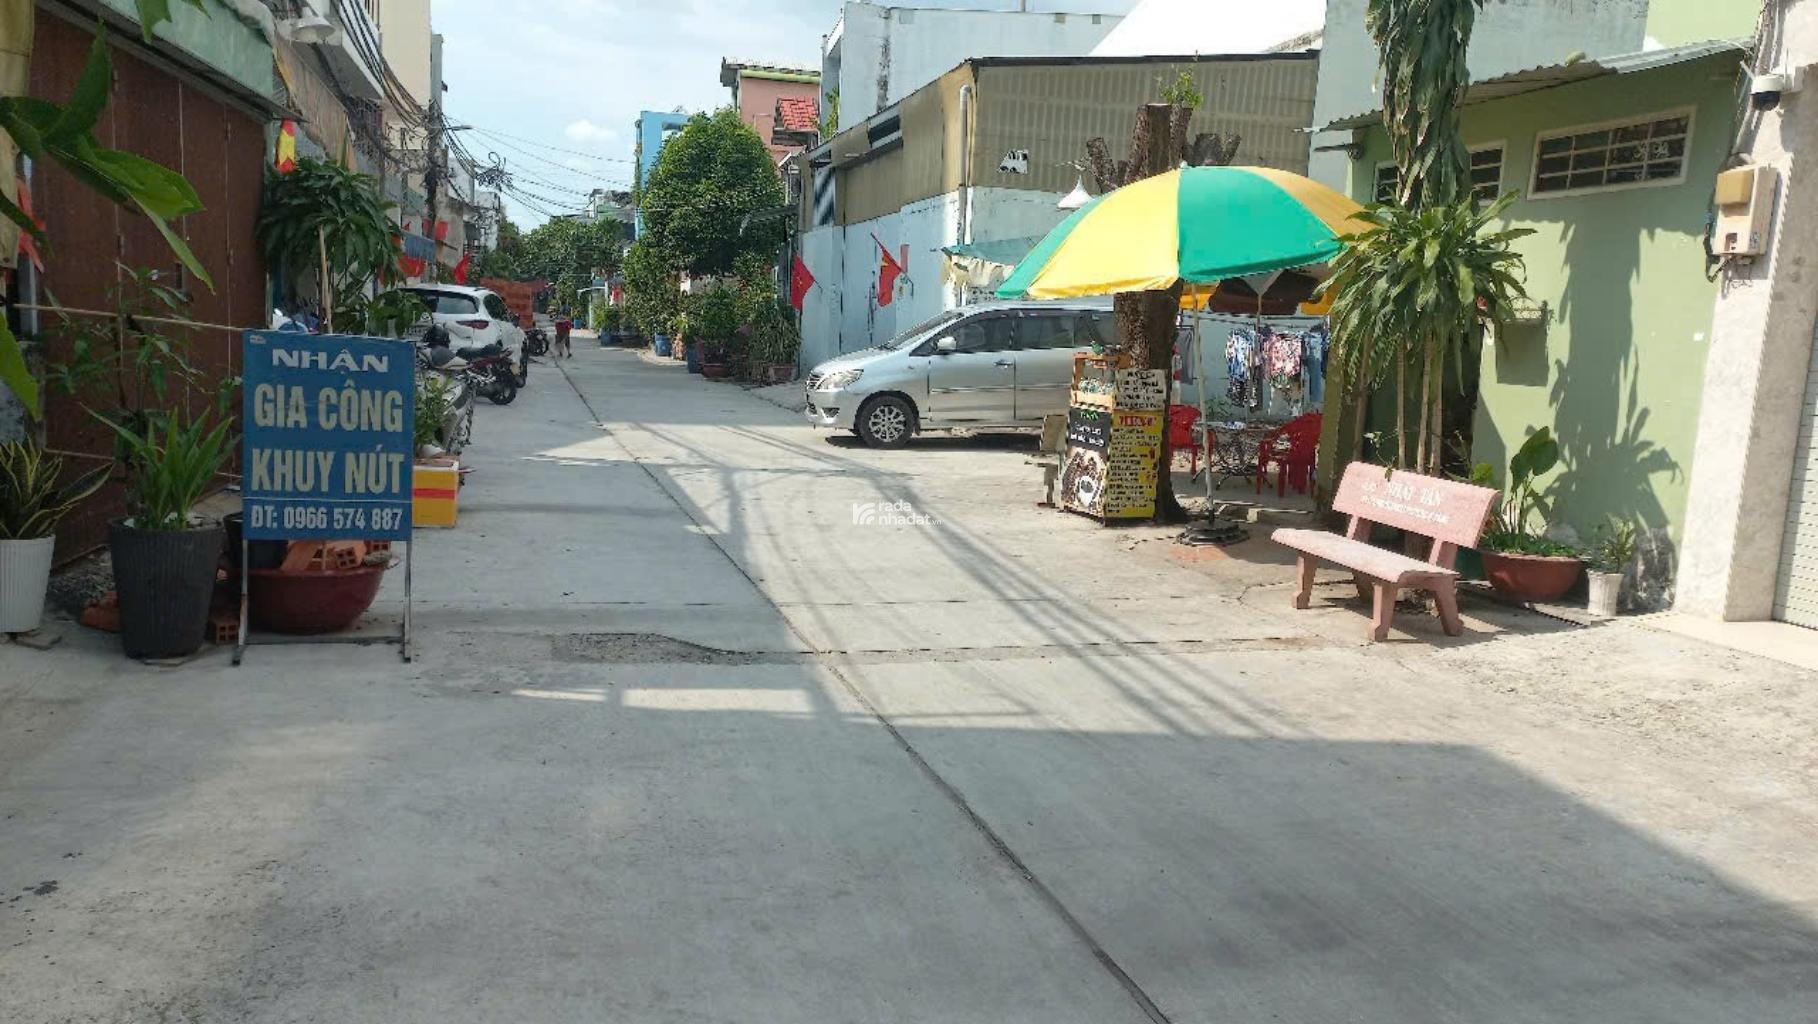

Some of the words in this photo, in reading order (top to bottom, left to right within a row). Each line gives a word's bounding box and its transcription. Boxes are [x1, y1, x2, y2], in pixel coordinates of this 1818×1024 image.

[272, 348, 389, 374] NHẬN
[254, 383, 307, 429] GIA
[318, 379, 403, 433] CÔNG
[251, 448, 335, 492] KHUY
[344, 444, 405, 494] NÚT
[251, 505, 278, 529] ĐT:
[284, 506, 327, 529] 0966
[333, 508, 366, 530] 574
[371, 508, 403, 530] 887
